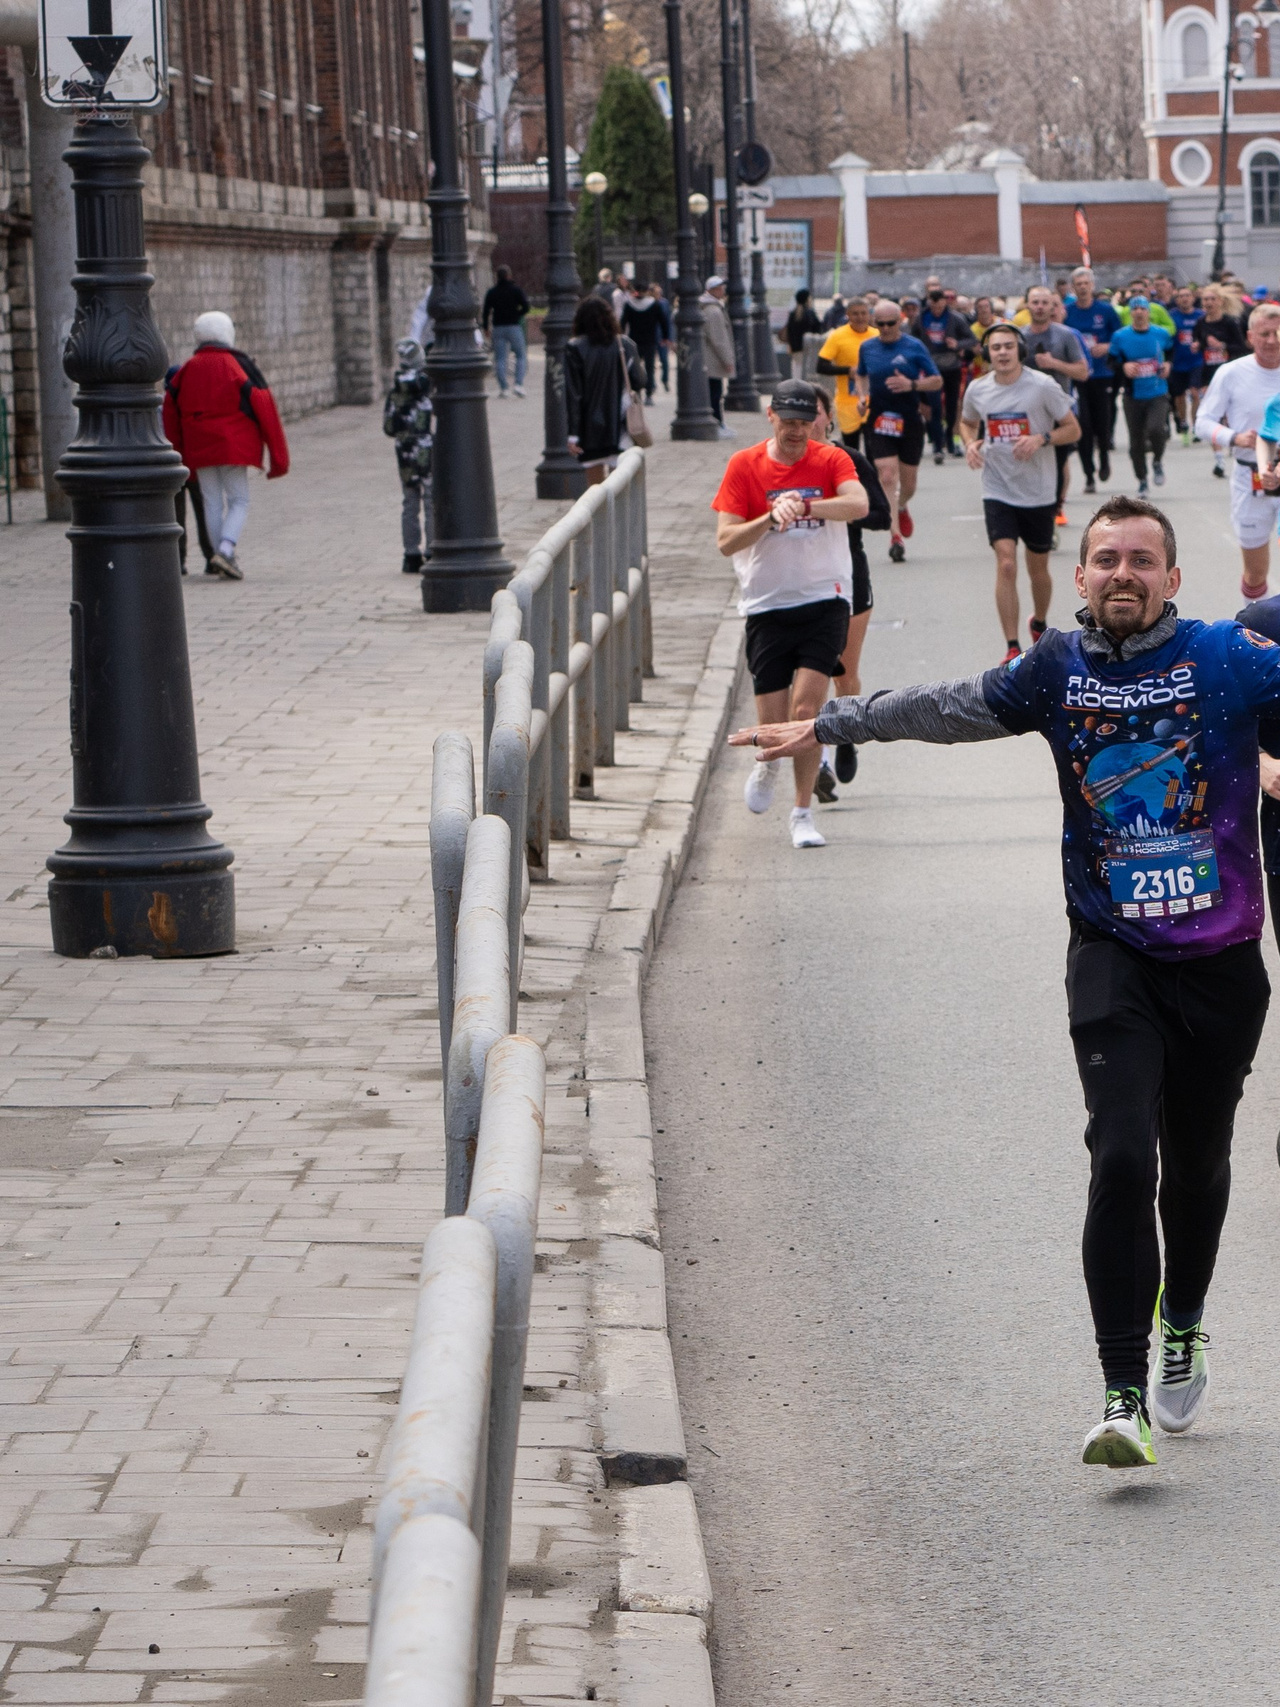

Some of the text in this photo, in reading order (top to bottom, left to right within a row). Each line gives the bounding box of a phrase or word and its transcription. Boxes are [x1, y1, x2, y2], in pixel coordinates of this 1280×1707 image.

[1066, 682, 1196, 708] КОСМОС
[1135, 845, 1180, 854] КОСМОС
[1131, 866, 1195, 899] 2316
